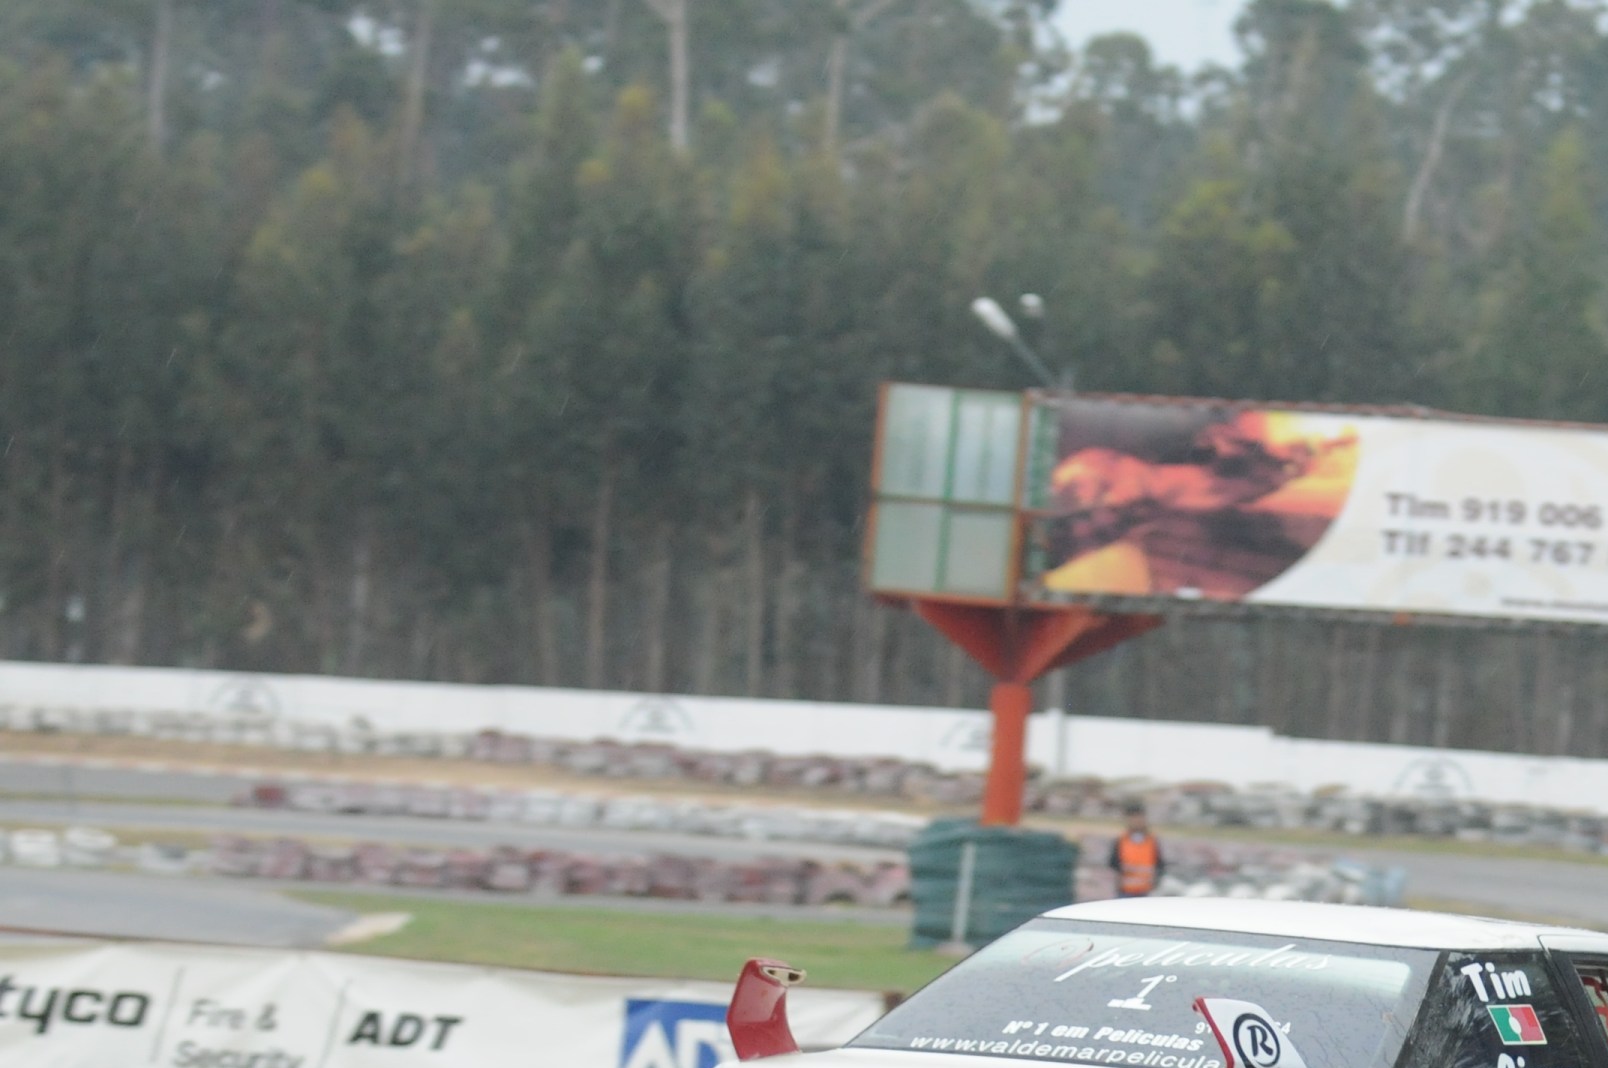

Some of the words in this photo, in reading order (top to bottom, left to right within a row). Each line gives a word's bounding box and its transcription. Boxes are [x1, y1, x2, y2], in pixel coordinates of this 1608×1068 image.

[1461, 498, 1528, 525] 919
[1537, 501, 1603, 530] 006
[1446, 533, 1513, 560] 244
[1527, 538, 1595, 566] 767
[1460, 962, 1532, 1003] Tim
[0, 974, 152, 1036] tyco
[187, 1000, 246, 1030] Fire
[255, 1002, 279, 1032] &
[347, 1010, 463, 1053] ADT
[1034, 1022, 1047, 1036] 1
[1049, 1025, 1087, 1040] em
